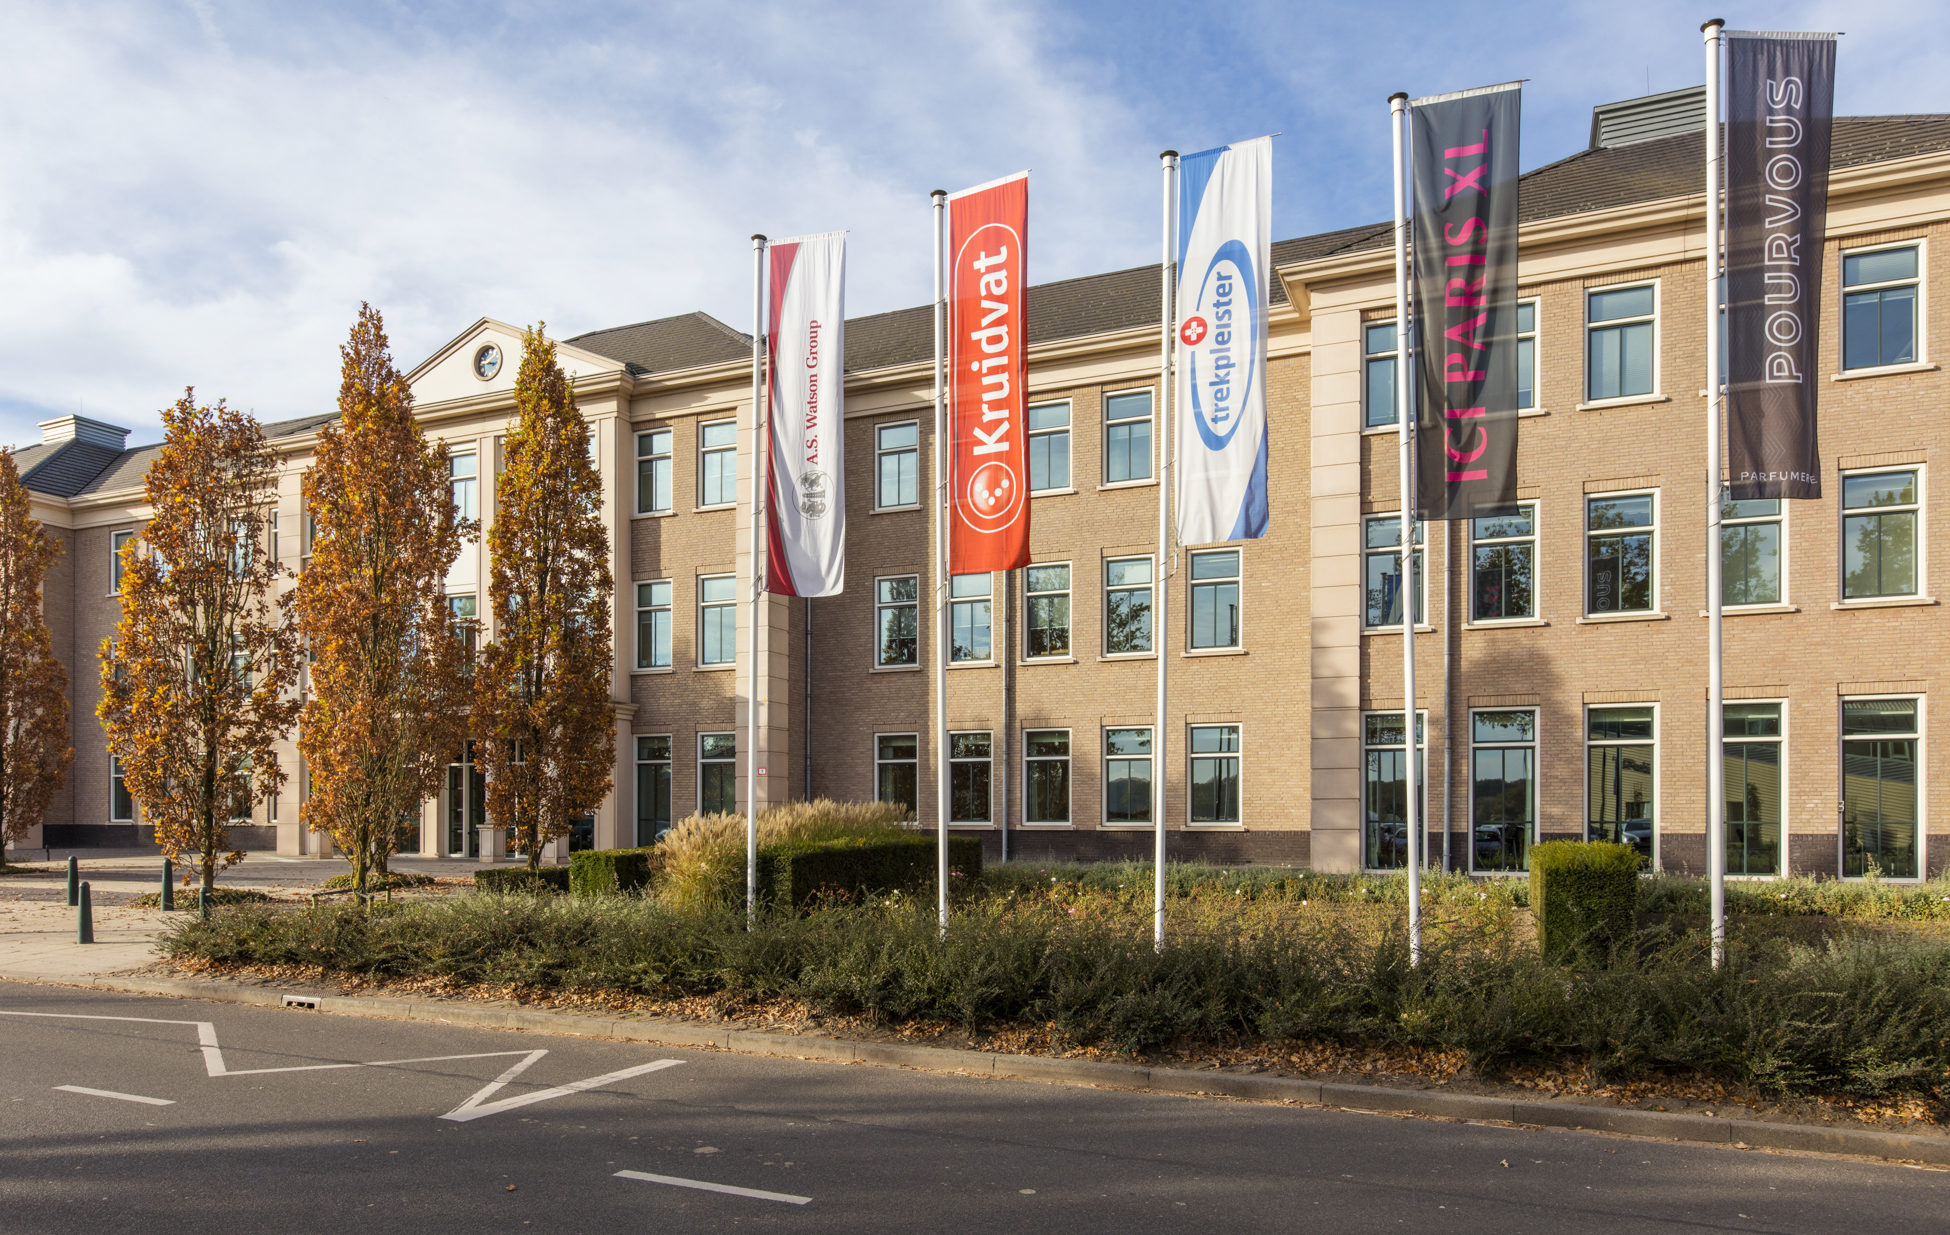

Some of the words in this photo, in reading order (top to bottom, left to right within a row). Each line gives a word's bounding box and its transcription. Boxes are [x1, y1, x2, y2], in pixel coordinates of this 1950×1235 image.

[1444, 128, 1489, 201] XL
[1764, 75, 1803, 384] POURVOUS
[1444, 215, 1488, 383] PARIS
[806, 319, 823, 369] Group
[971, 244, 1010, 457] Kruidvat
[1208, 271, 1237, 425] trekpleister
[806, 373, 818, 431] Watson
[806, 434, 819, 466] A.S.
[1445, 404, 1488, 483] ICI
